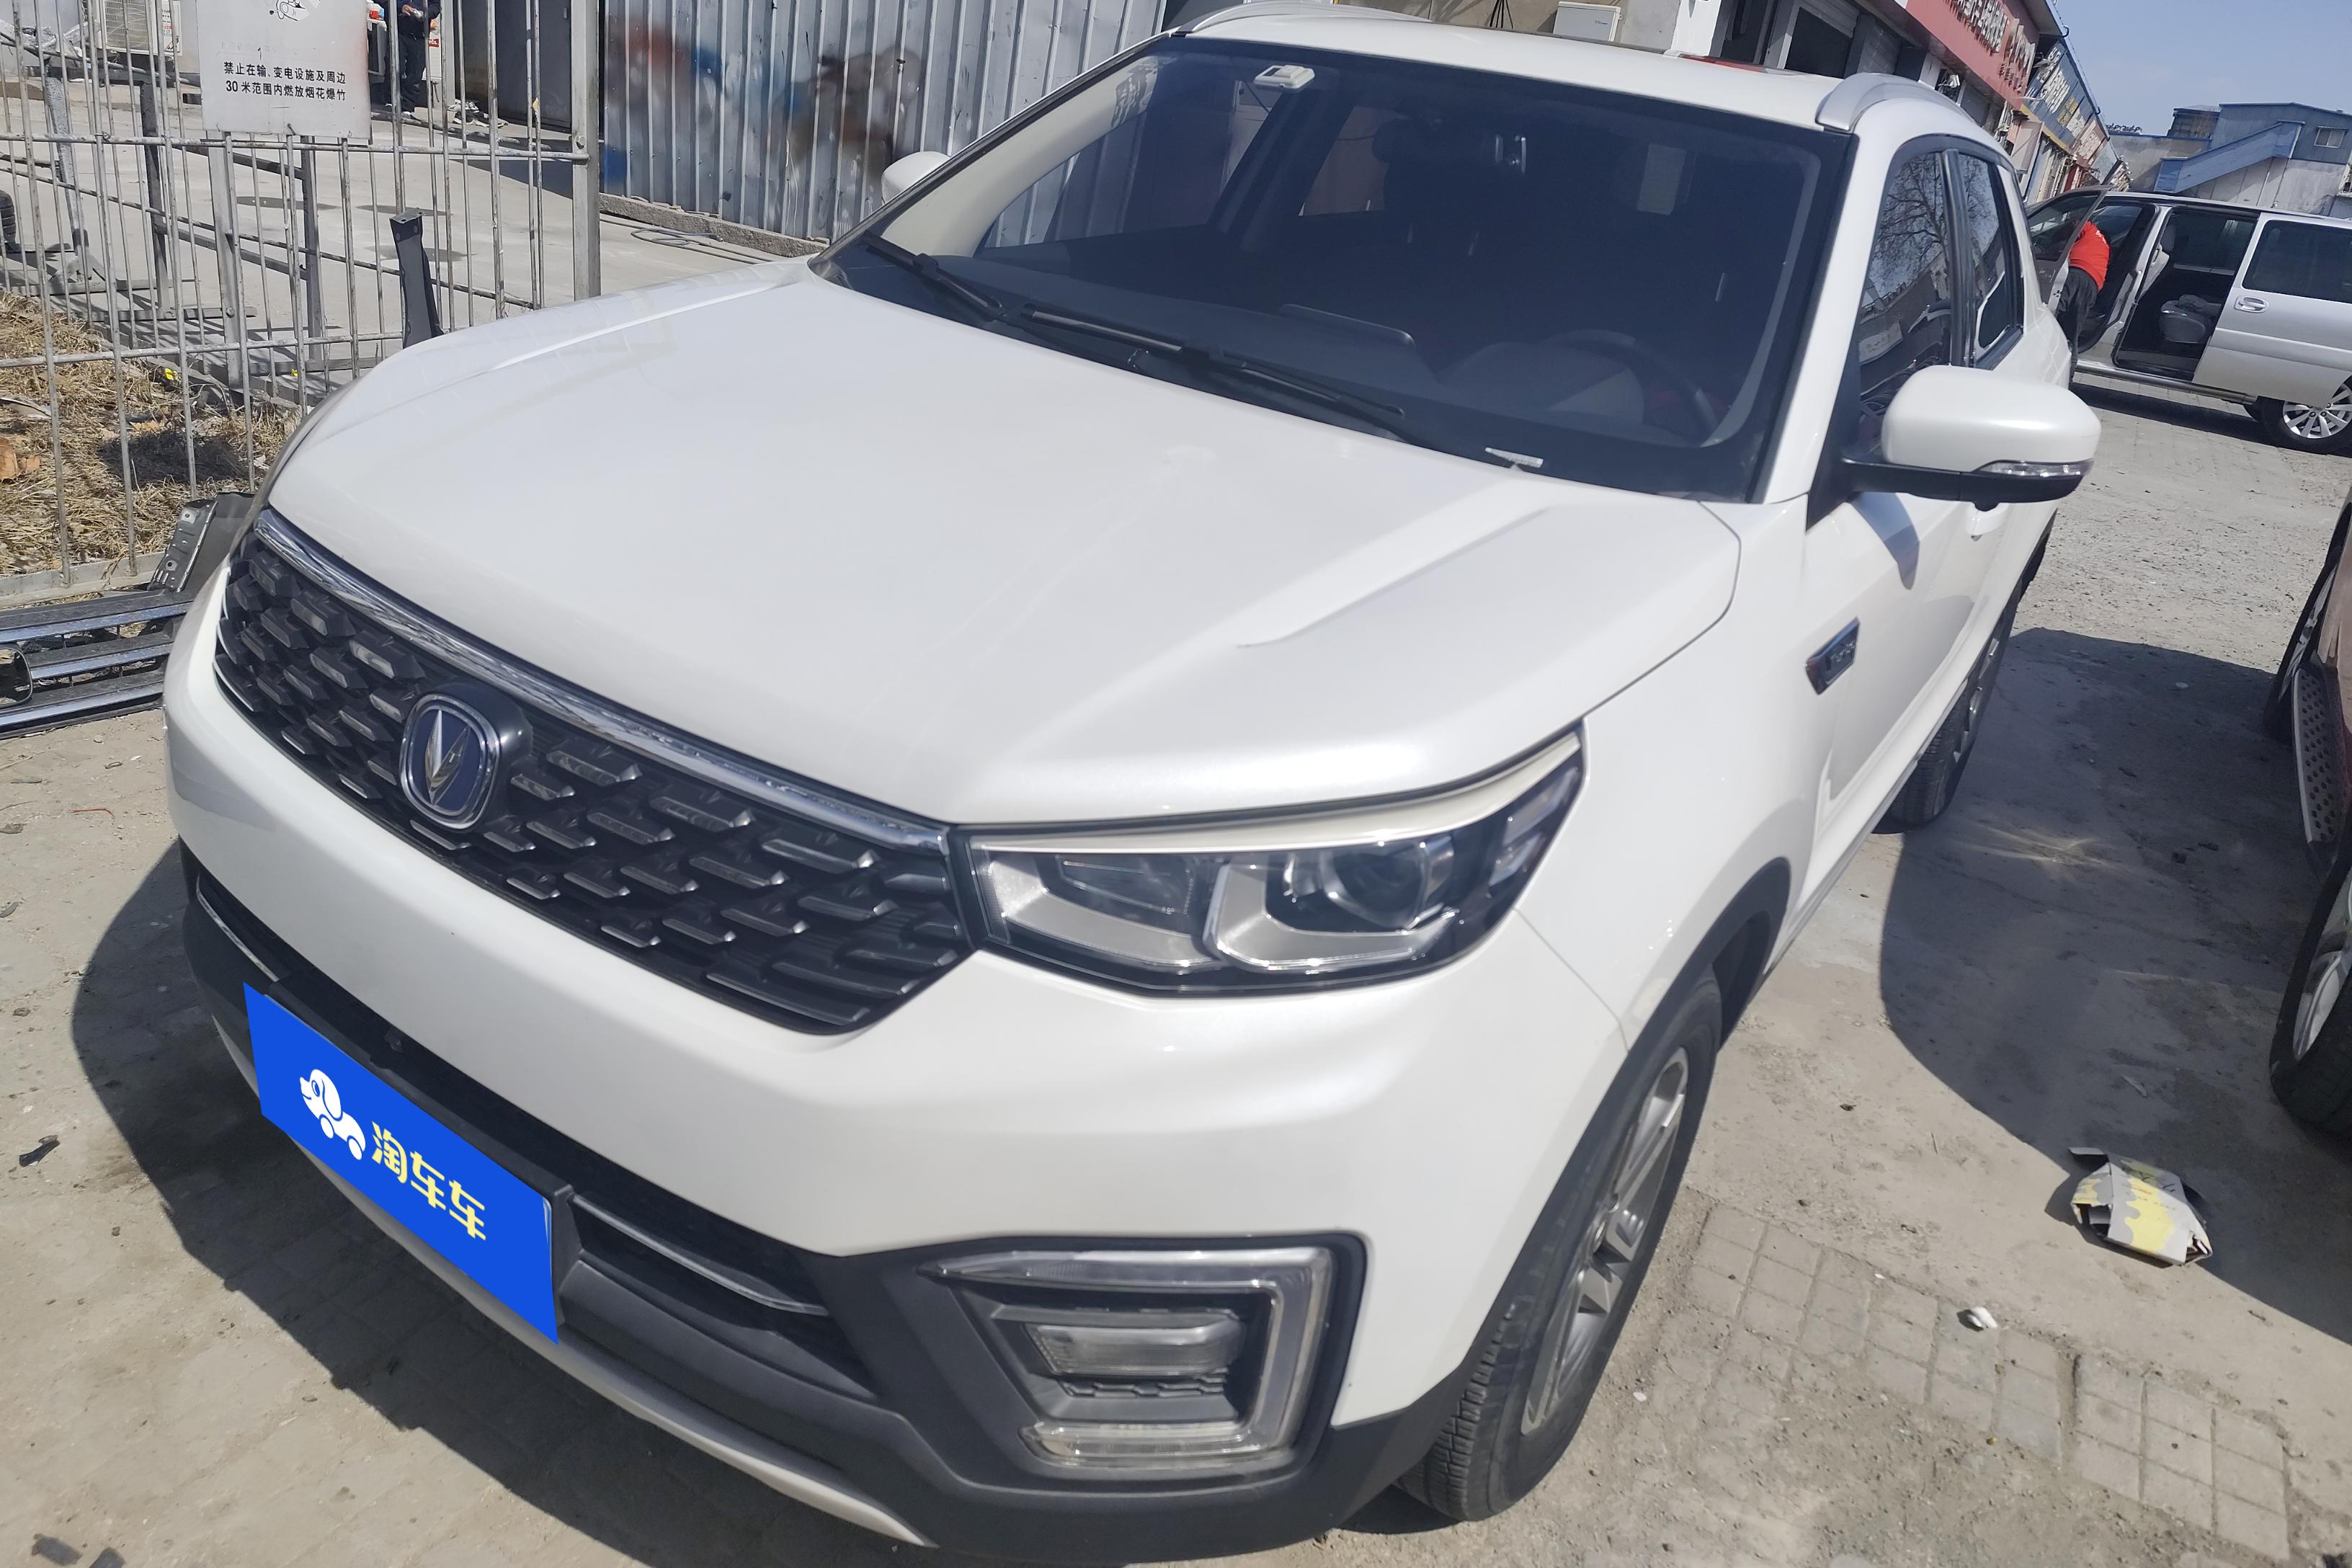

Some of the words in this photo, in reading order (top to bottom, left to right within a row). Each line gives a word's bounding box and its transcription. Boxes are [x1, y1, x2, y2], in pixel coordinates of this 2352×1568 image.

[223, 61, 346, 84] 禁止在输、变电设施及周边
